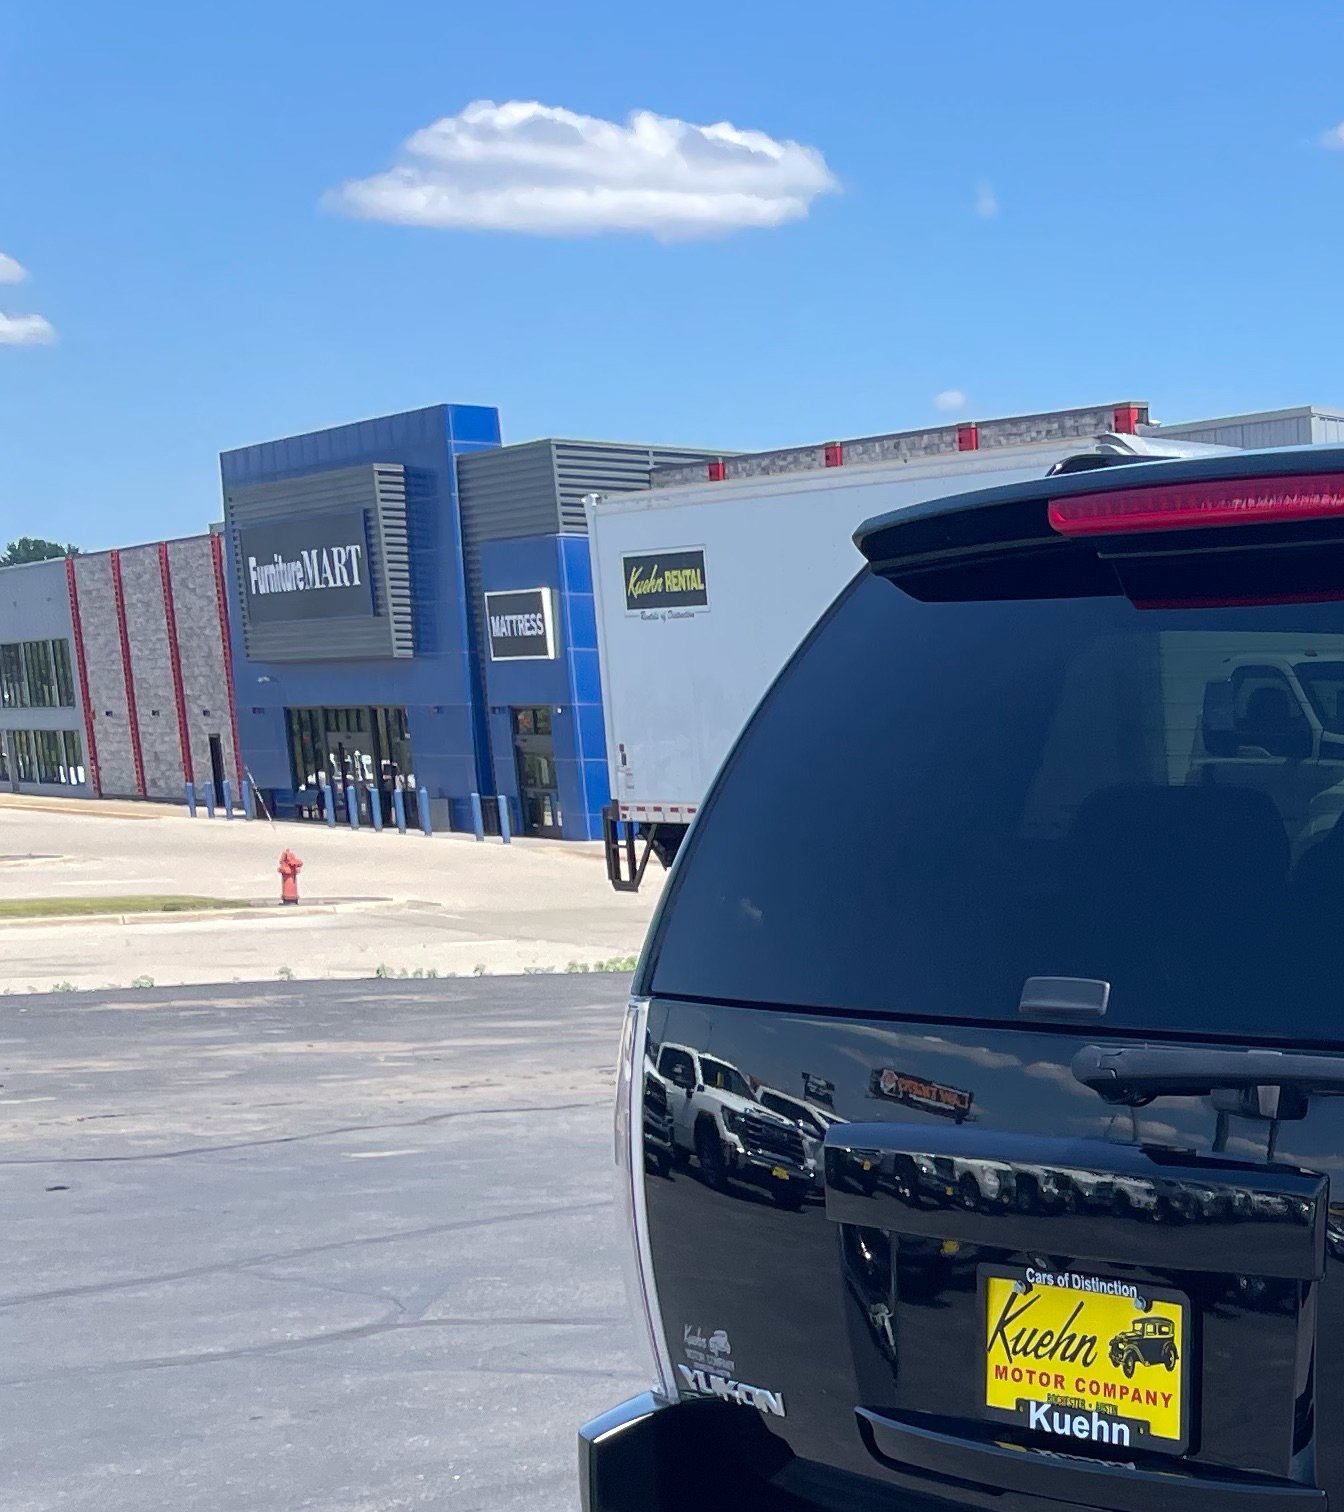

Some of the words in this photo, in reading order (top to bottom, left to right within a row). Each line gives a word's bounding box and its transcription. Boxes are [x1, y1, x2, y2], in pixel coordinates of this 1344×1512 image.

[627, 564, 664, 599] Kuehn
[664, 568, 705, 592] RENTAL
[490, 612, 544, 637] MATTRESS
[1025, 1267, 1054, 1286] Cars
[1056, 1272, 1070, 1288] of
[1071, 1272, 1138, 1299] Distinction
[987, 1291, 1098, 1368] Kuehn
[677, 1363, 786, 1418] YUKON
[994, 1364, 1066, 1390] MOTOR
[1074, 1377, 1173, 1408] COMPANY
[1029, 1400, 1130, 1447] Kuehn
